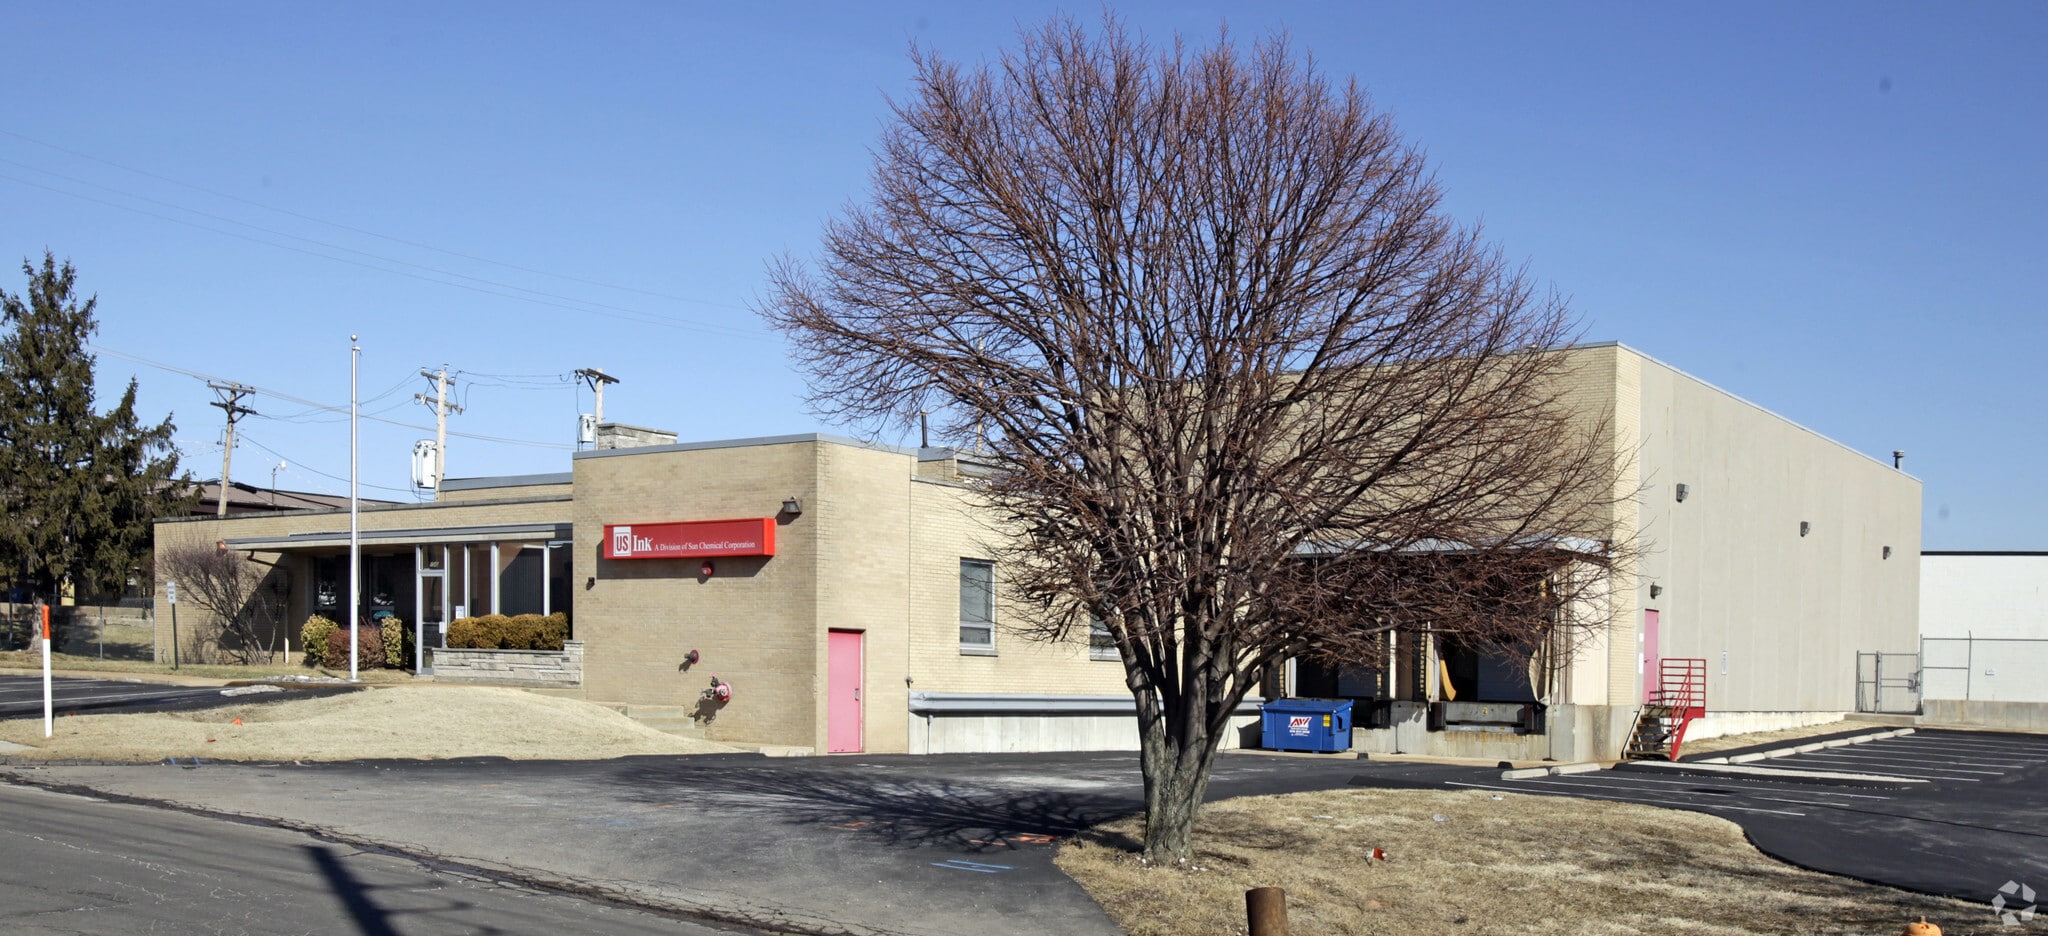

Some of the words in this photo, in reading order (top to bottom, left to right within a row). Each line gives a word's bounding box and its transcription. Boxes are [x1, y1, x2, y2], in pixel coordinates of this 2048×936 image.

[616, 535, 628, 551] US
[633, 535, 653, 551] Ink
[660, 543, 681, 551] Division
[682, 542, 688, 550] of
[688, 542, 699, 550] Sun
[699, 541, 723, 550] Chemical
[724, 541, 755, 551] Corporation
